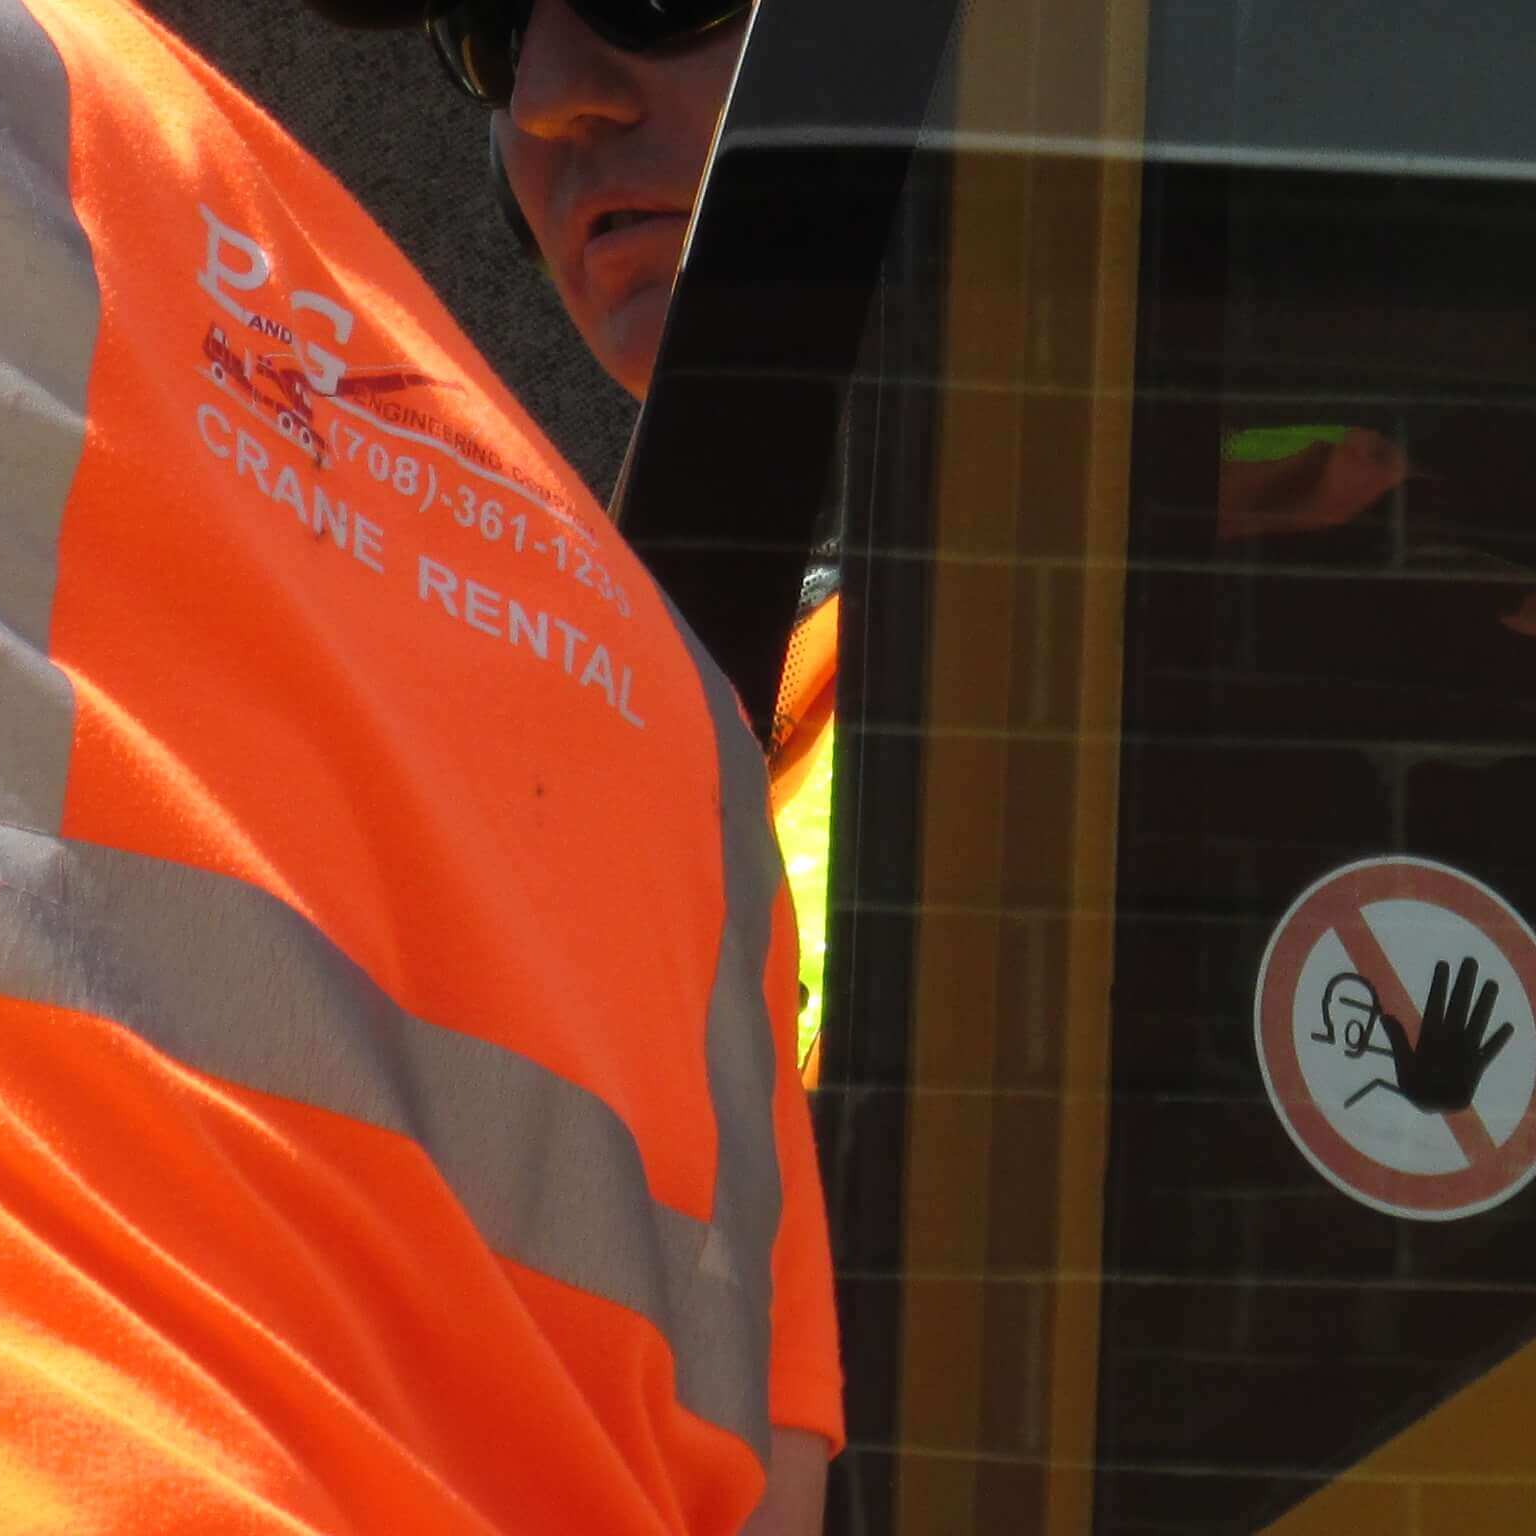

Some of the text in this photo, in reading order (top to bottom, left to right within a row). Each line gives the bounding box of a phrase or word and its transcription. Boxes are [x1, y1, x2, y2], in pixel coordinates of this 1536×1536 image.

[248, 313, 294, 345] AND
[290, 289, 356, 397] G
[353, 390, 503, 470] ENGINEERING
[197, 403, 646, 730] CRANE RENTAL
